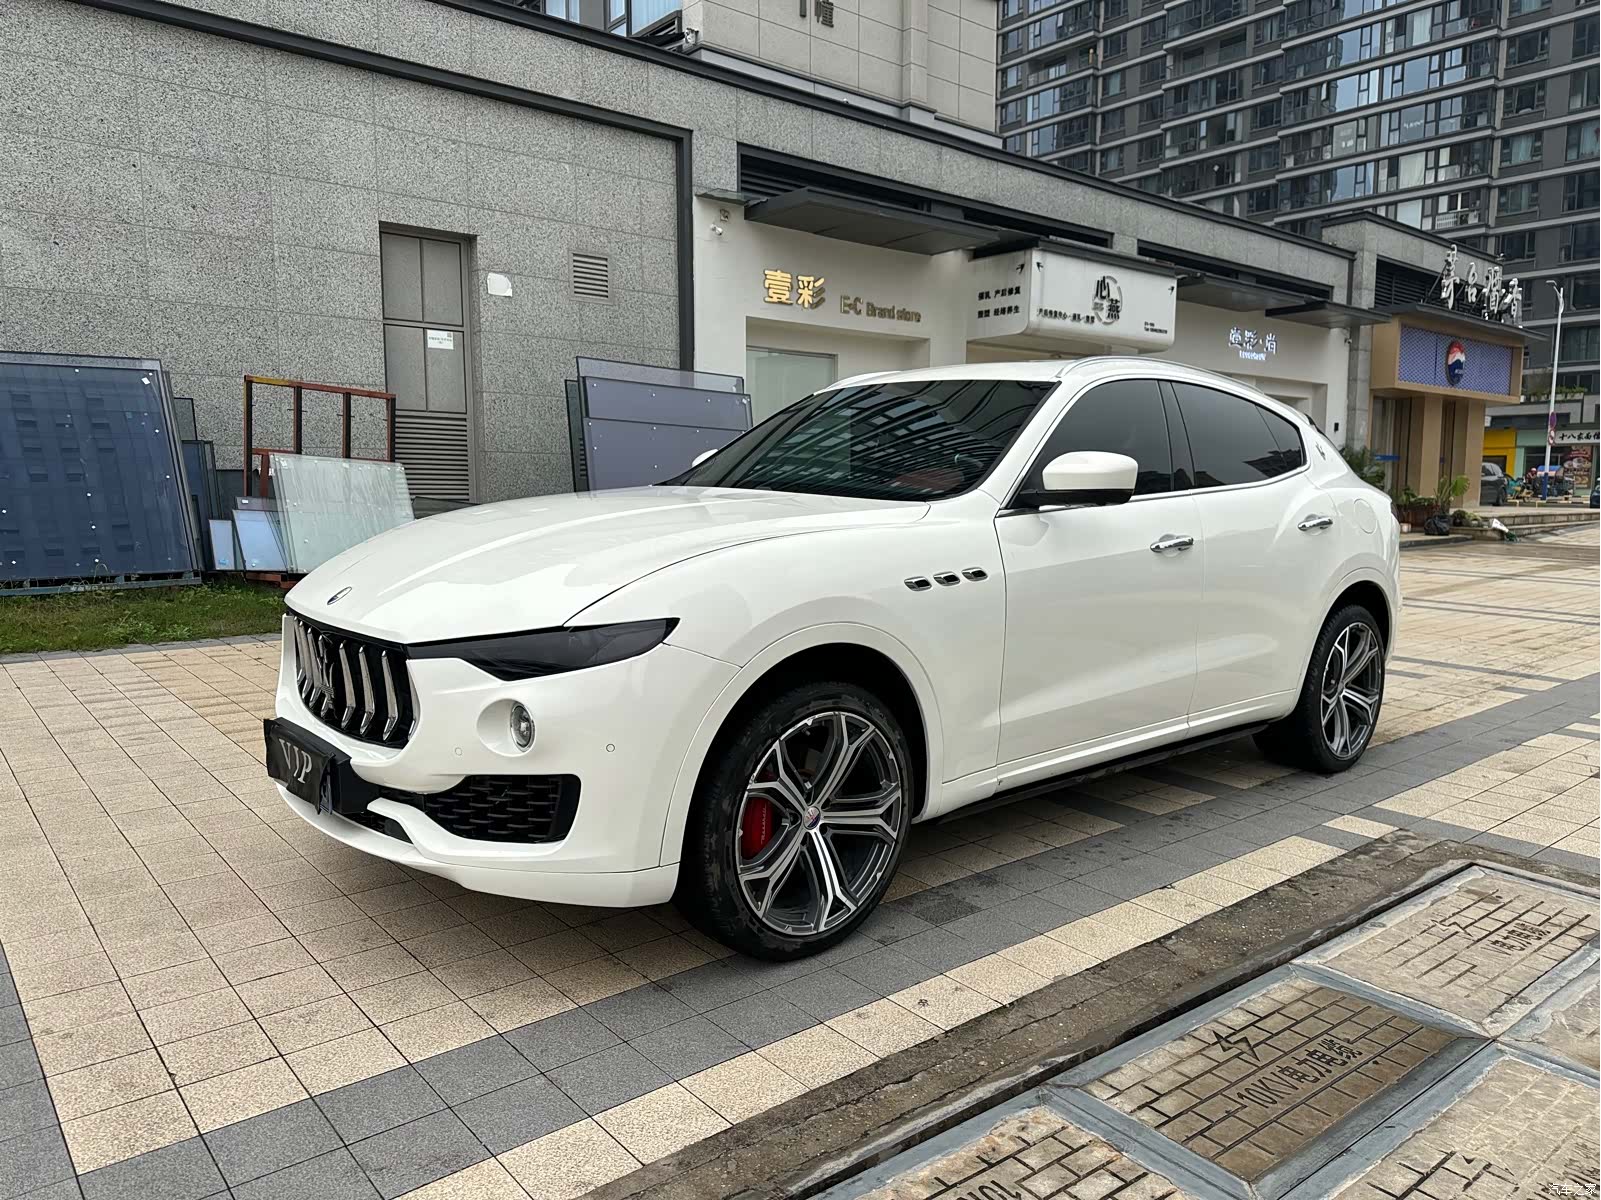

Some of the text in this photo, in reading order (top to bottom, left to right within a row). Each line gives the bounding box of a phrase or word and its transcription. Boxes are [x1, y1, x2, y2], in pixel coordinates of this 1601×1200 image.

[763, 269, 826, 310] 壹彩
[866, 302, 895, 320] Brand
[279, 738, 313, 784] VIP
